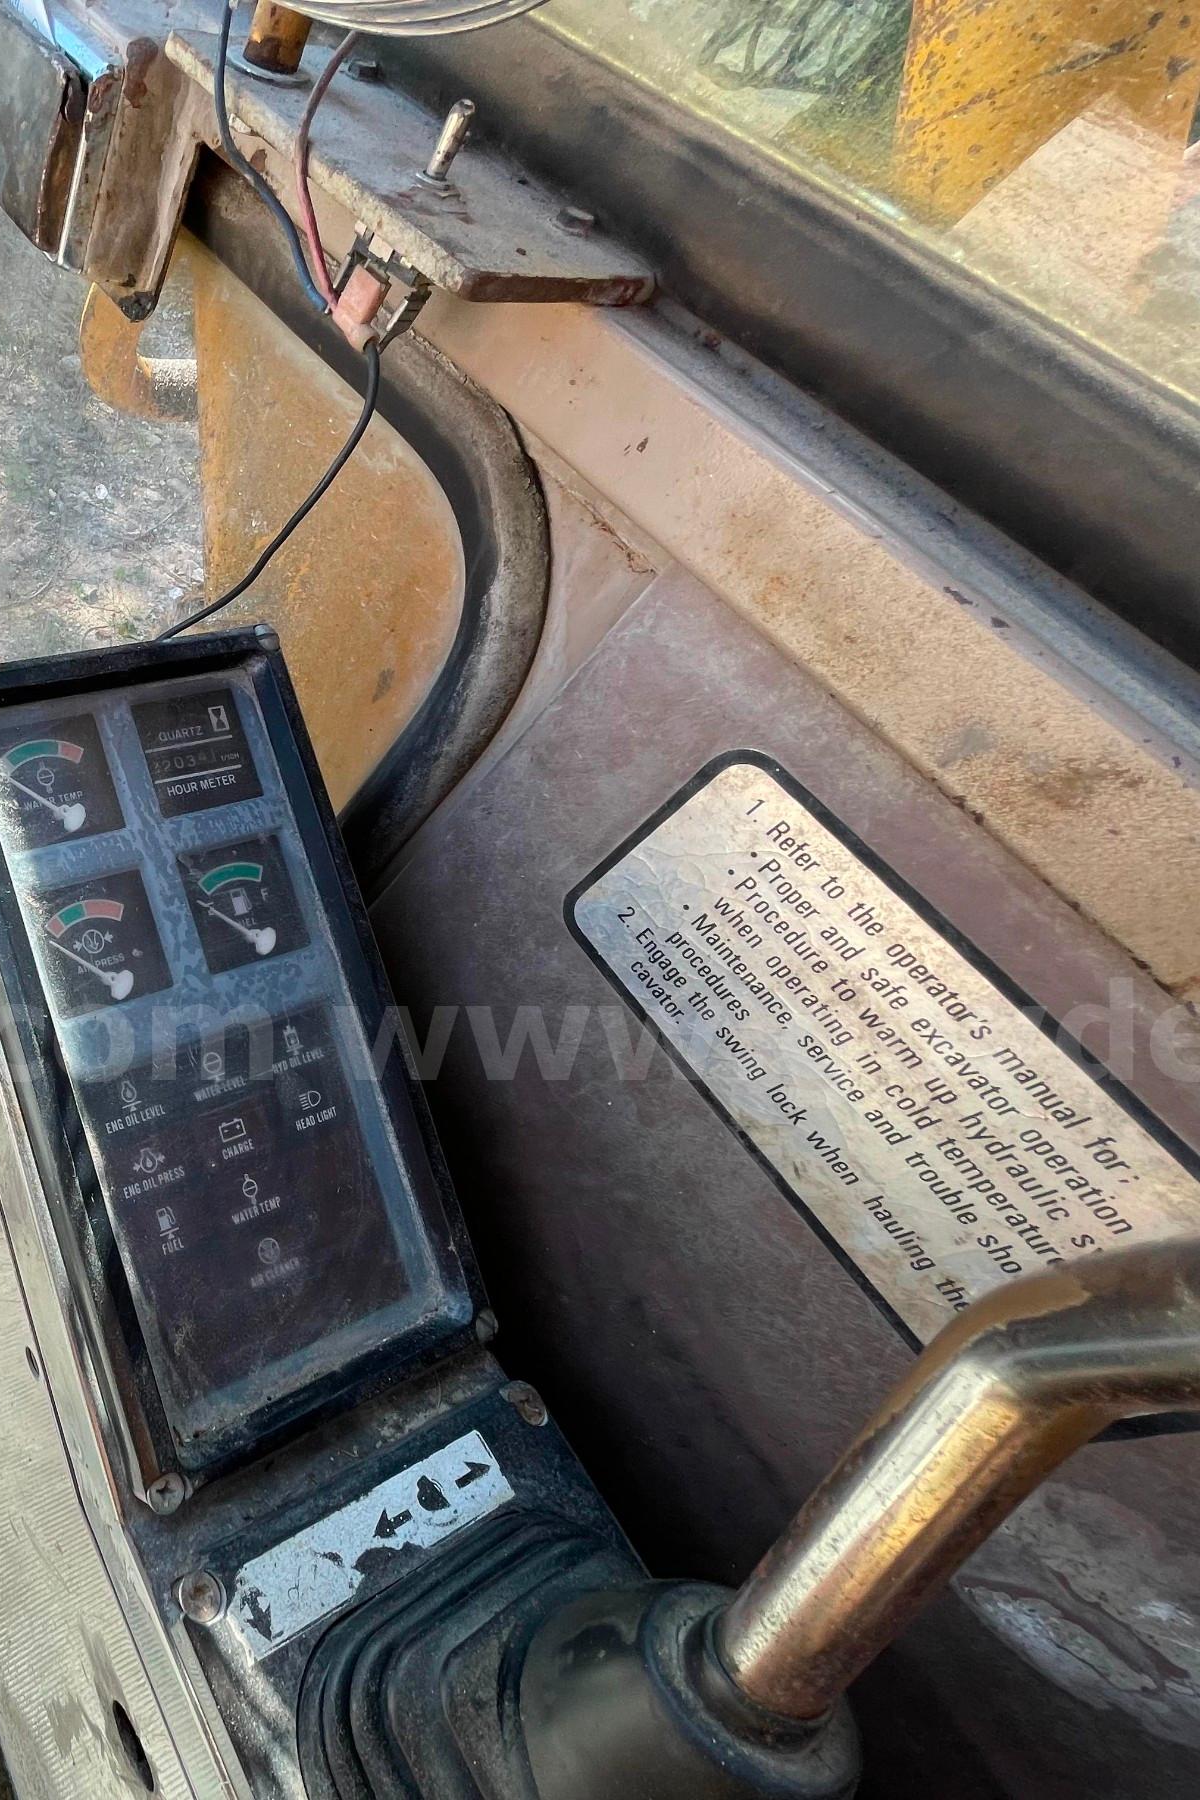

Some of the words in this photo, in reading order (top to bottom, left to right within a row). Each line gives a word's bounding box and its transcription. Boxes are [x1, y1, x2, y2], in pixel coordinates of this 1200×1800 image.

[158, 725, 204, 742] QUARTZ
[167, 781, 199, 797] HOUR
[200, 774, 237, 791] METER
[23, 796, 57, 811] WAR
[58, 790, 84, 803] TEMP
[260, 887, 269, 902] F
[94, 952, 126, 969] PRESS
[746, 799, 765, 823] 1.
[766, 820, 821, 872] Refer
[821, 875, 845, 899] to
[847, 901, 884, 936] the
[886, 943, 992, 1041] operator's
[993, 1047, 1092, 1129] manual
[666, 931, 751, 1022] procedures
[630, 960, 685, 1024] cavator.
[714, 897, 763, 949] when
[766, 955, 854, 1046] operating
[856, 1050, 882, 1075] in
[885, 1083, 942, 1130] cold
[288, 1055, 302, 1069] OIL
[302, 1048, 325, 1064] LEVEL
[734, 876, 828, 974] Procedure
[830, 977, 856, 1001] to
[859, 1007, 923, 1070] warm
[924, 1077, 958, 1105] up
[958, 1111, 1070, 1221] hydraulic
[758, 858, 821, 919] Proper
[820, 926, 866, 961] and
[861, 967, 909, 1010] safe
[910, 1018, 1019, 1116] excavator
[1019, 1129, 1133, 1235] operation
[221, 1076, 247, 1093] LEVEL
[617, 906, 636, 928] 2.
[635, 927, 688, 988] Engage
[688, 991, 716, 1021] the
[716, 1026, 767, 1081] swing
[766, 1083, 807, 1126] lock
[806, 1131, 860, 1186] when
[863, 1195, 936, 1271] hauling
[691, 912, 793, 1030] Maintenance,
[798, 1034, 865, 1102] service
[864, 1109, 912, 1146] and
[905, 1151, 978, 1225] trouble
[977, 1233, 1022, 1274] sho
[105, 1118, 125, 1134] ENG
[125, 1113, 140, 1126] OIL
[140, 1104, 166, 1122] LEVEL
[295, 1115, 316, 1131] HEAD
[316, 1106, 337, 1122] LIGHT
[221, 1138, 255, 1160] CHARGE
[123, 1183, 141, 1199] ENG
[142, 1177, 158, 1191] OIL
[158, 1165, 186, 1185] PRESS
[231, 1204, 260, 1225] WATER
[259, 1196, 281, 1213] TEMP
[161, 1236, 185, 1256] FUEL
